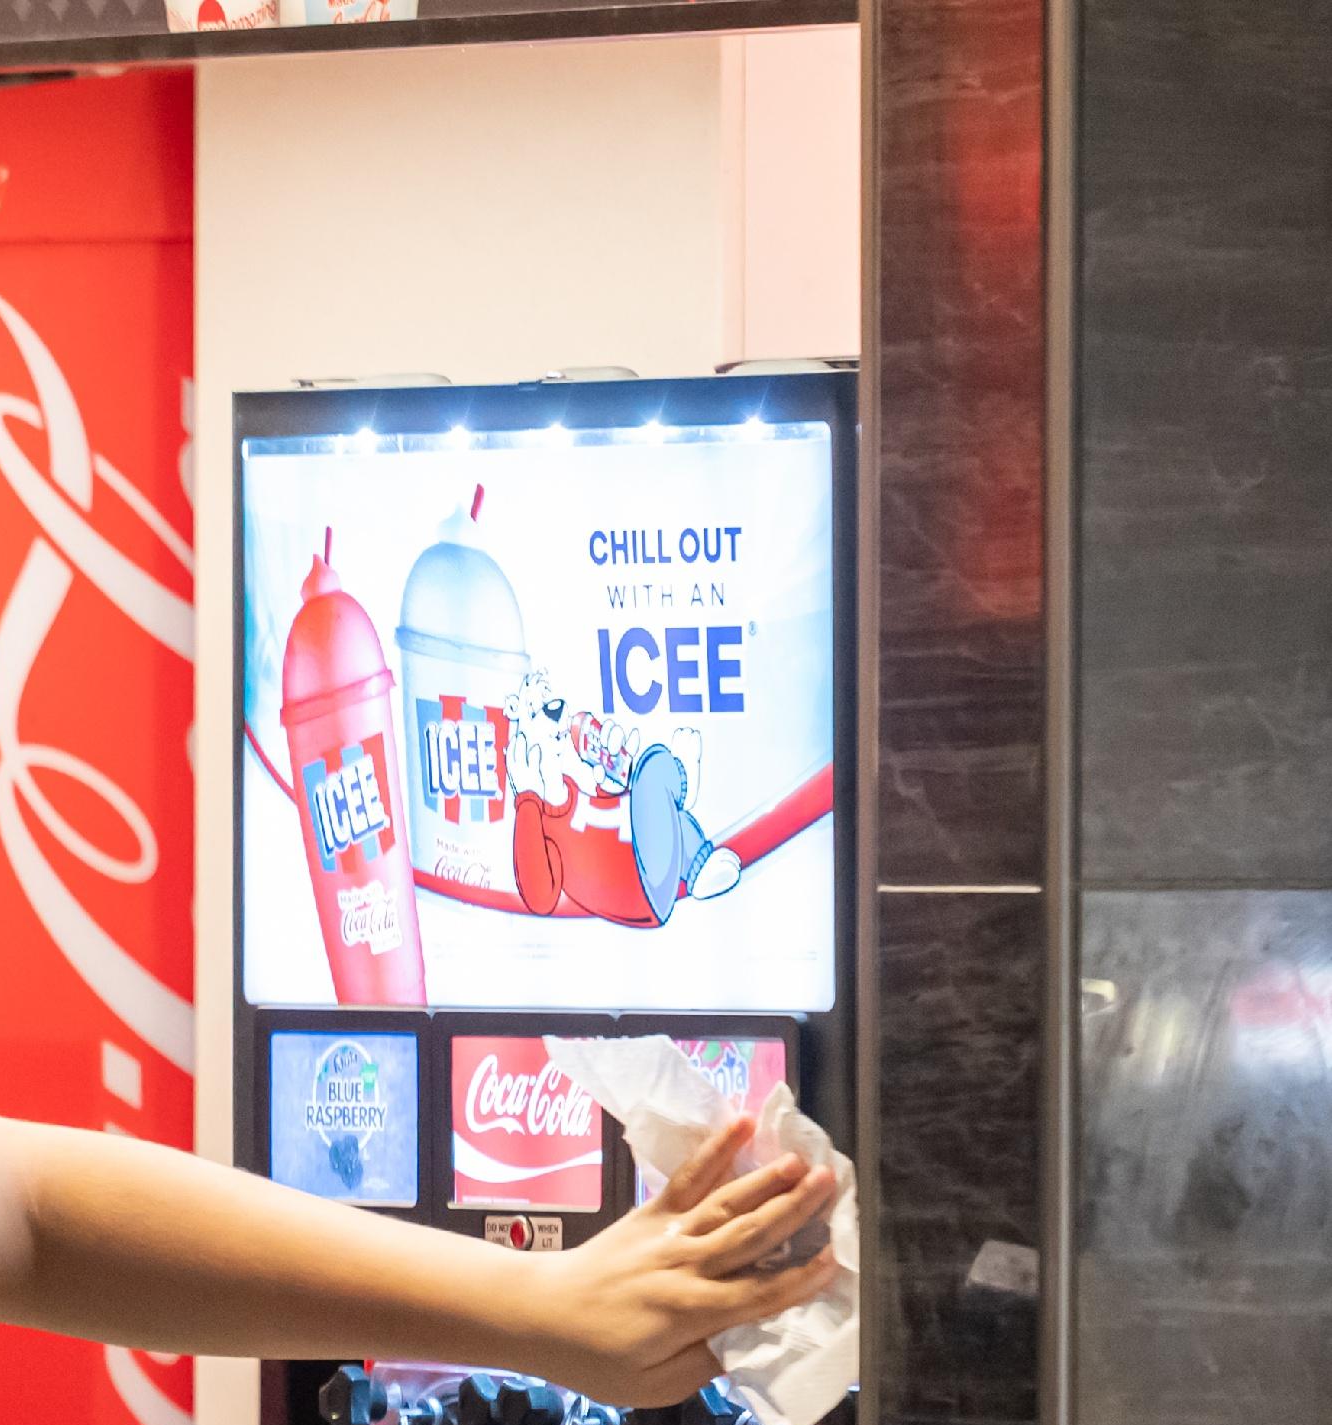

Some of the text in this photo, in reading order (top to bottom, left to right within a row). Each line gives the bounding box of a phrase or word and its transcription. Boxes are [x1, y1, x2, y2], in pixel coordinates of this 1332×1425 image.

[589, 526, 742, 566] CHILL OUT
[606, 582, 725, 609] WITH AN
[597, 625, 745, 715] ICEE
[424, 720, 498, 797] ICEE
[314, 755, 386, 857] ICEE
[327, 1081, 363, 1103] BLUE
[465, 1054, 592, 1137] Coca-Cola
[305, 1104, 386, 1129] RASPBERRY
[486, 1222, 497, 1234] DO
[537, 1223, 559, 1234] WHEN
[541, 1237, 553, 1249] LIT
